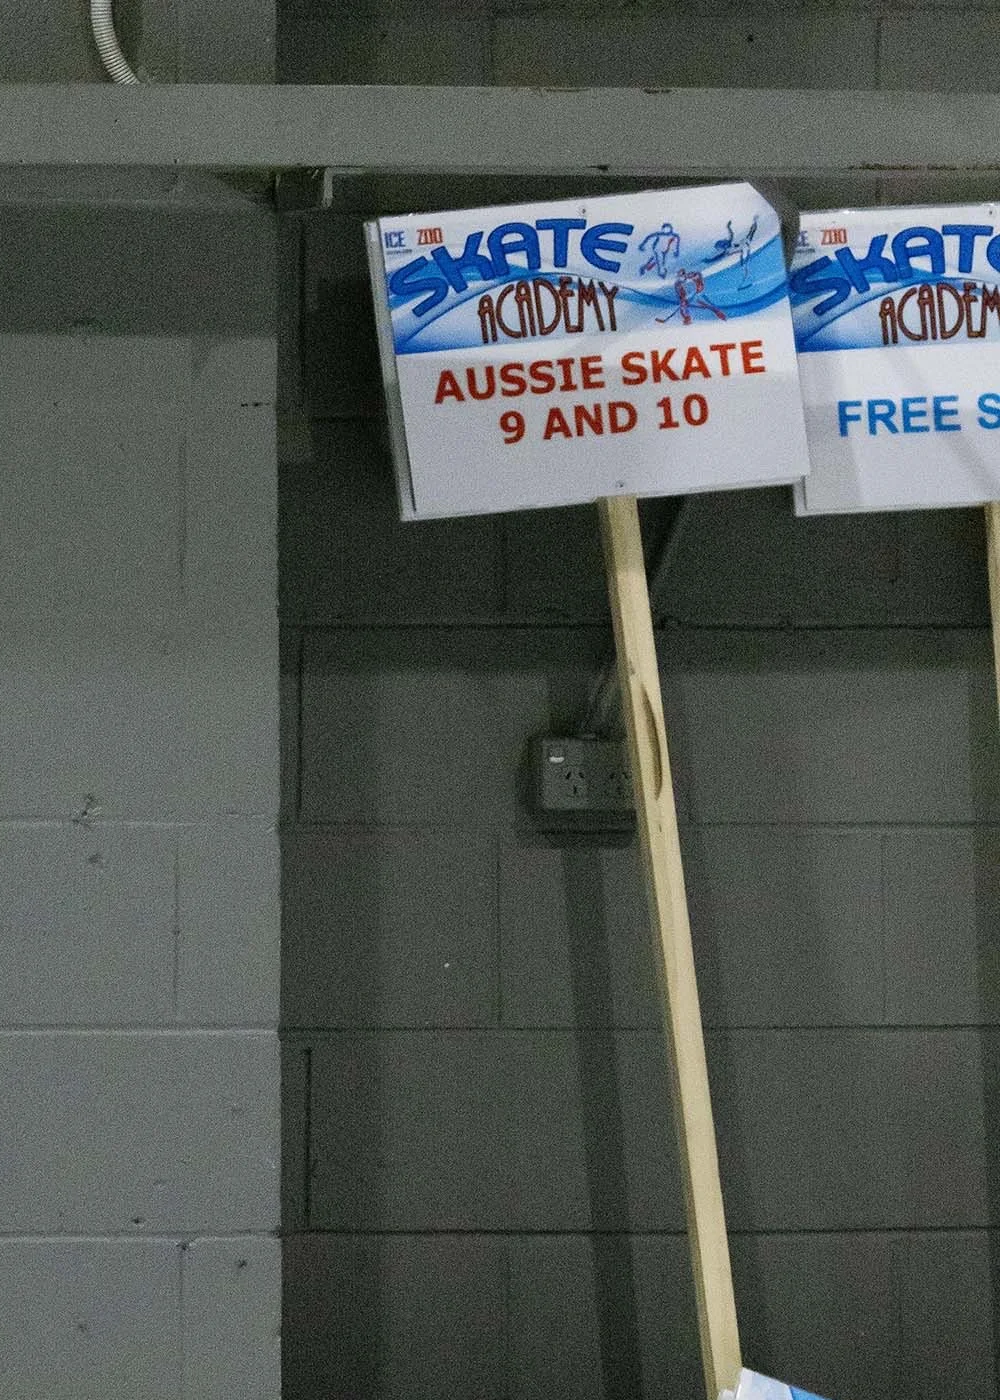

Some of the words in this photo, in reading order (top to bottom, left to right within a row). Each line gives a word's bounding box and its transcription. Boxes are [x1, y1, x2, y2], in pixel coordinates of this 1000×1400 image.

[384, 231, 405, 249] ICE
[416, 227, 443, 246] ZOO
[389, 218, 634, 318] SKATE
[790, 224, 1000, 316] SKAT
[478, 276, 619, 344] ACADEMY
[434, 355, 606, 405] AUSSIE
[620, 340, 766, 386] SKATE
[500, 410, 526, 444] 9
[543, 401, 638, 440] AND
[656, 393, 709, 430] 10
[838, 395, 962, 437] FREE
